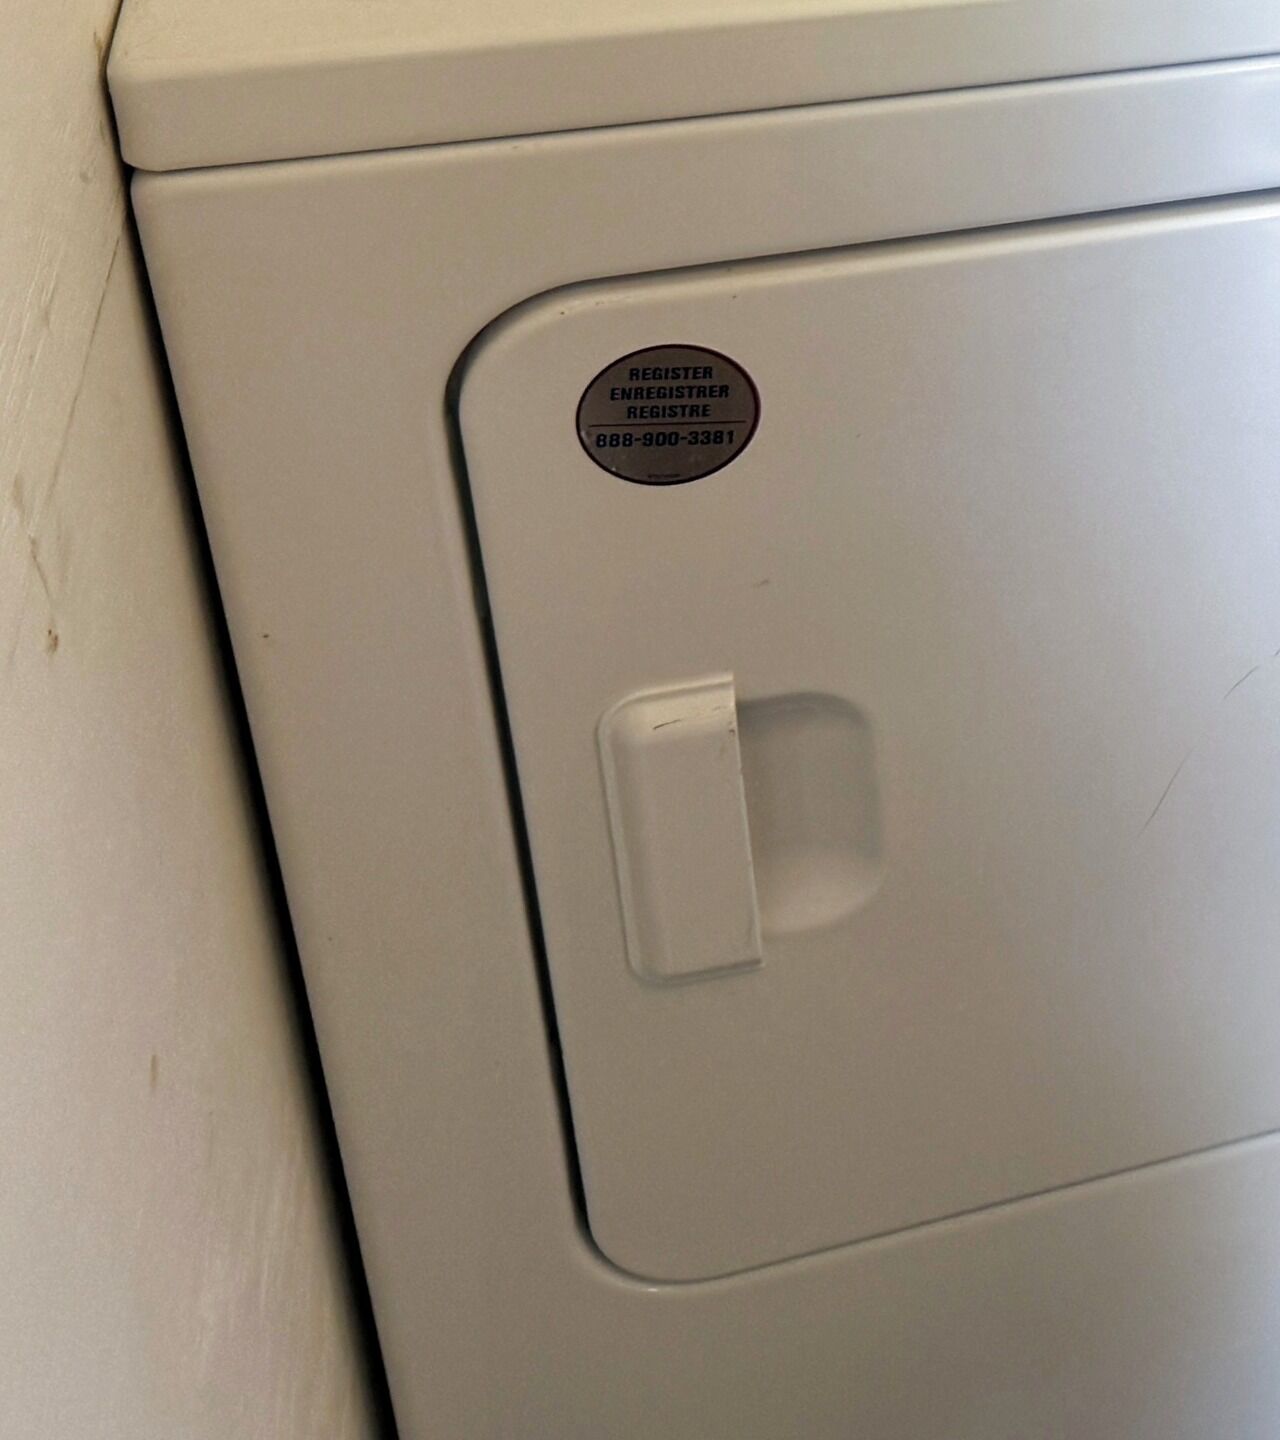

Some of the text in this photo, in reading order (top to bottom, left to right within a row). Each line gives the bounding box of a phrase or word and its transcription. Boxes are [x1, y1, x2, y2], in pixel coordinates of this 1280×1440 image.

[629, 366, 713, 381] REGISTER
[610, 385, 729, 401] ENREGISTRER
[627, 404, 711, 419] REGISTRE
[596, 430, 734, 448] 888-900-3381
